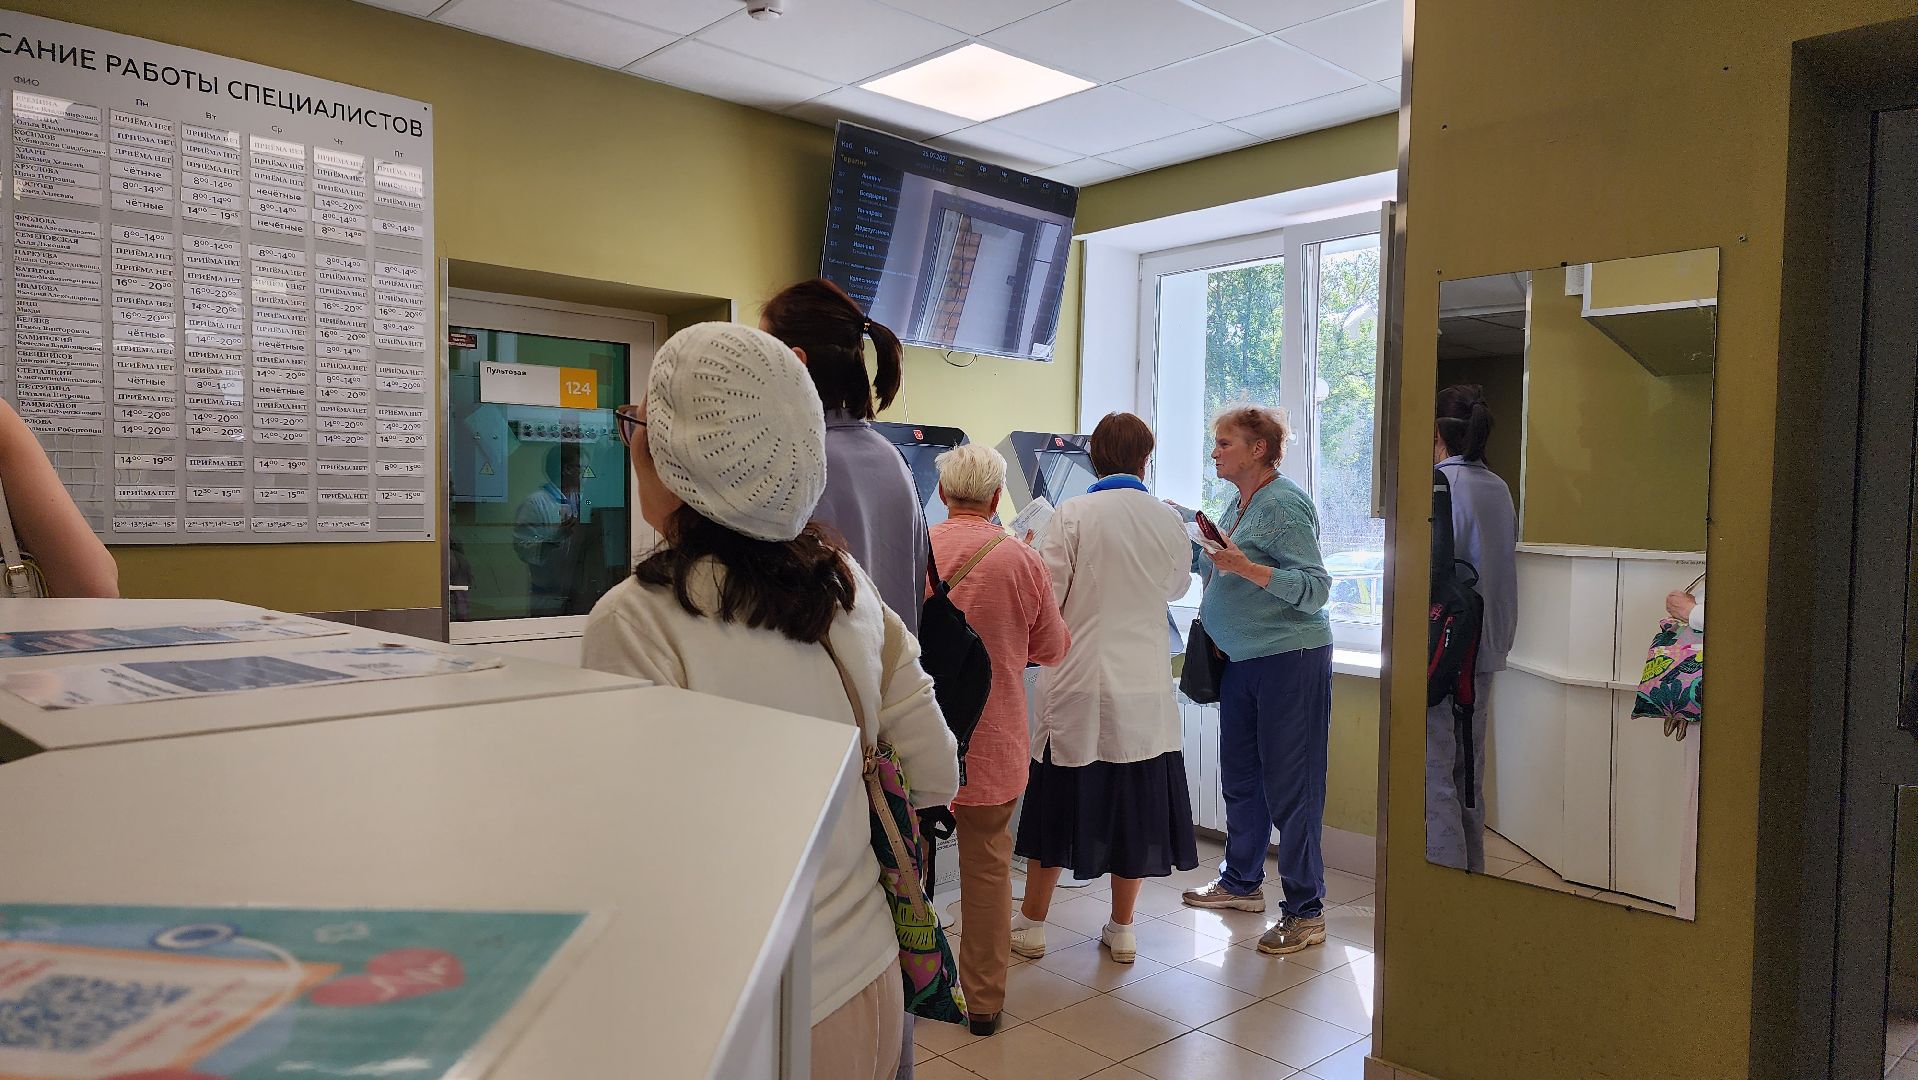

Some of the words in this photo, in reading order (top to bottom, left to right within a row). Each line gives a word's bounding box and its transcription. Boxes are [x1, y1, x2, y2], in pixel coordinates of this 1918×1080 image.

[13, 75, 40, 87] ФИО
[105, 53, 219, 95] РАБОТЫ
[228, 81, 423, 137] СПЕЦИАЛИСТОВ
[136, 99, 149, 107] Пн
[271, 125, 283, 134] Ср
[486, 367, 527, 376] Пультовая
[565, 381, 592, 396] 124
